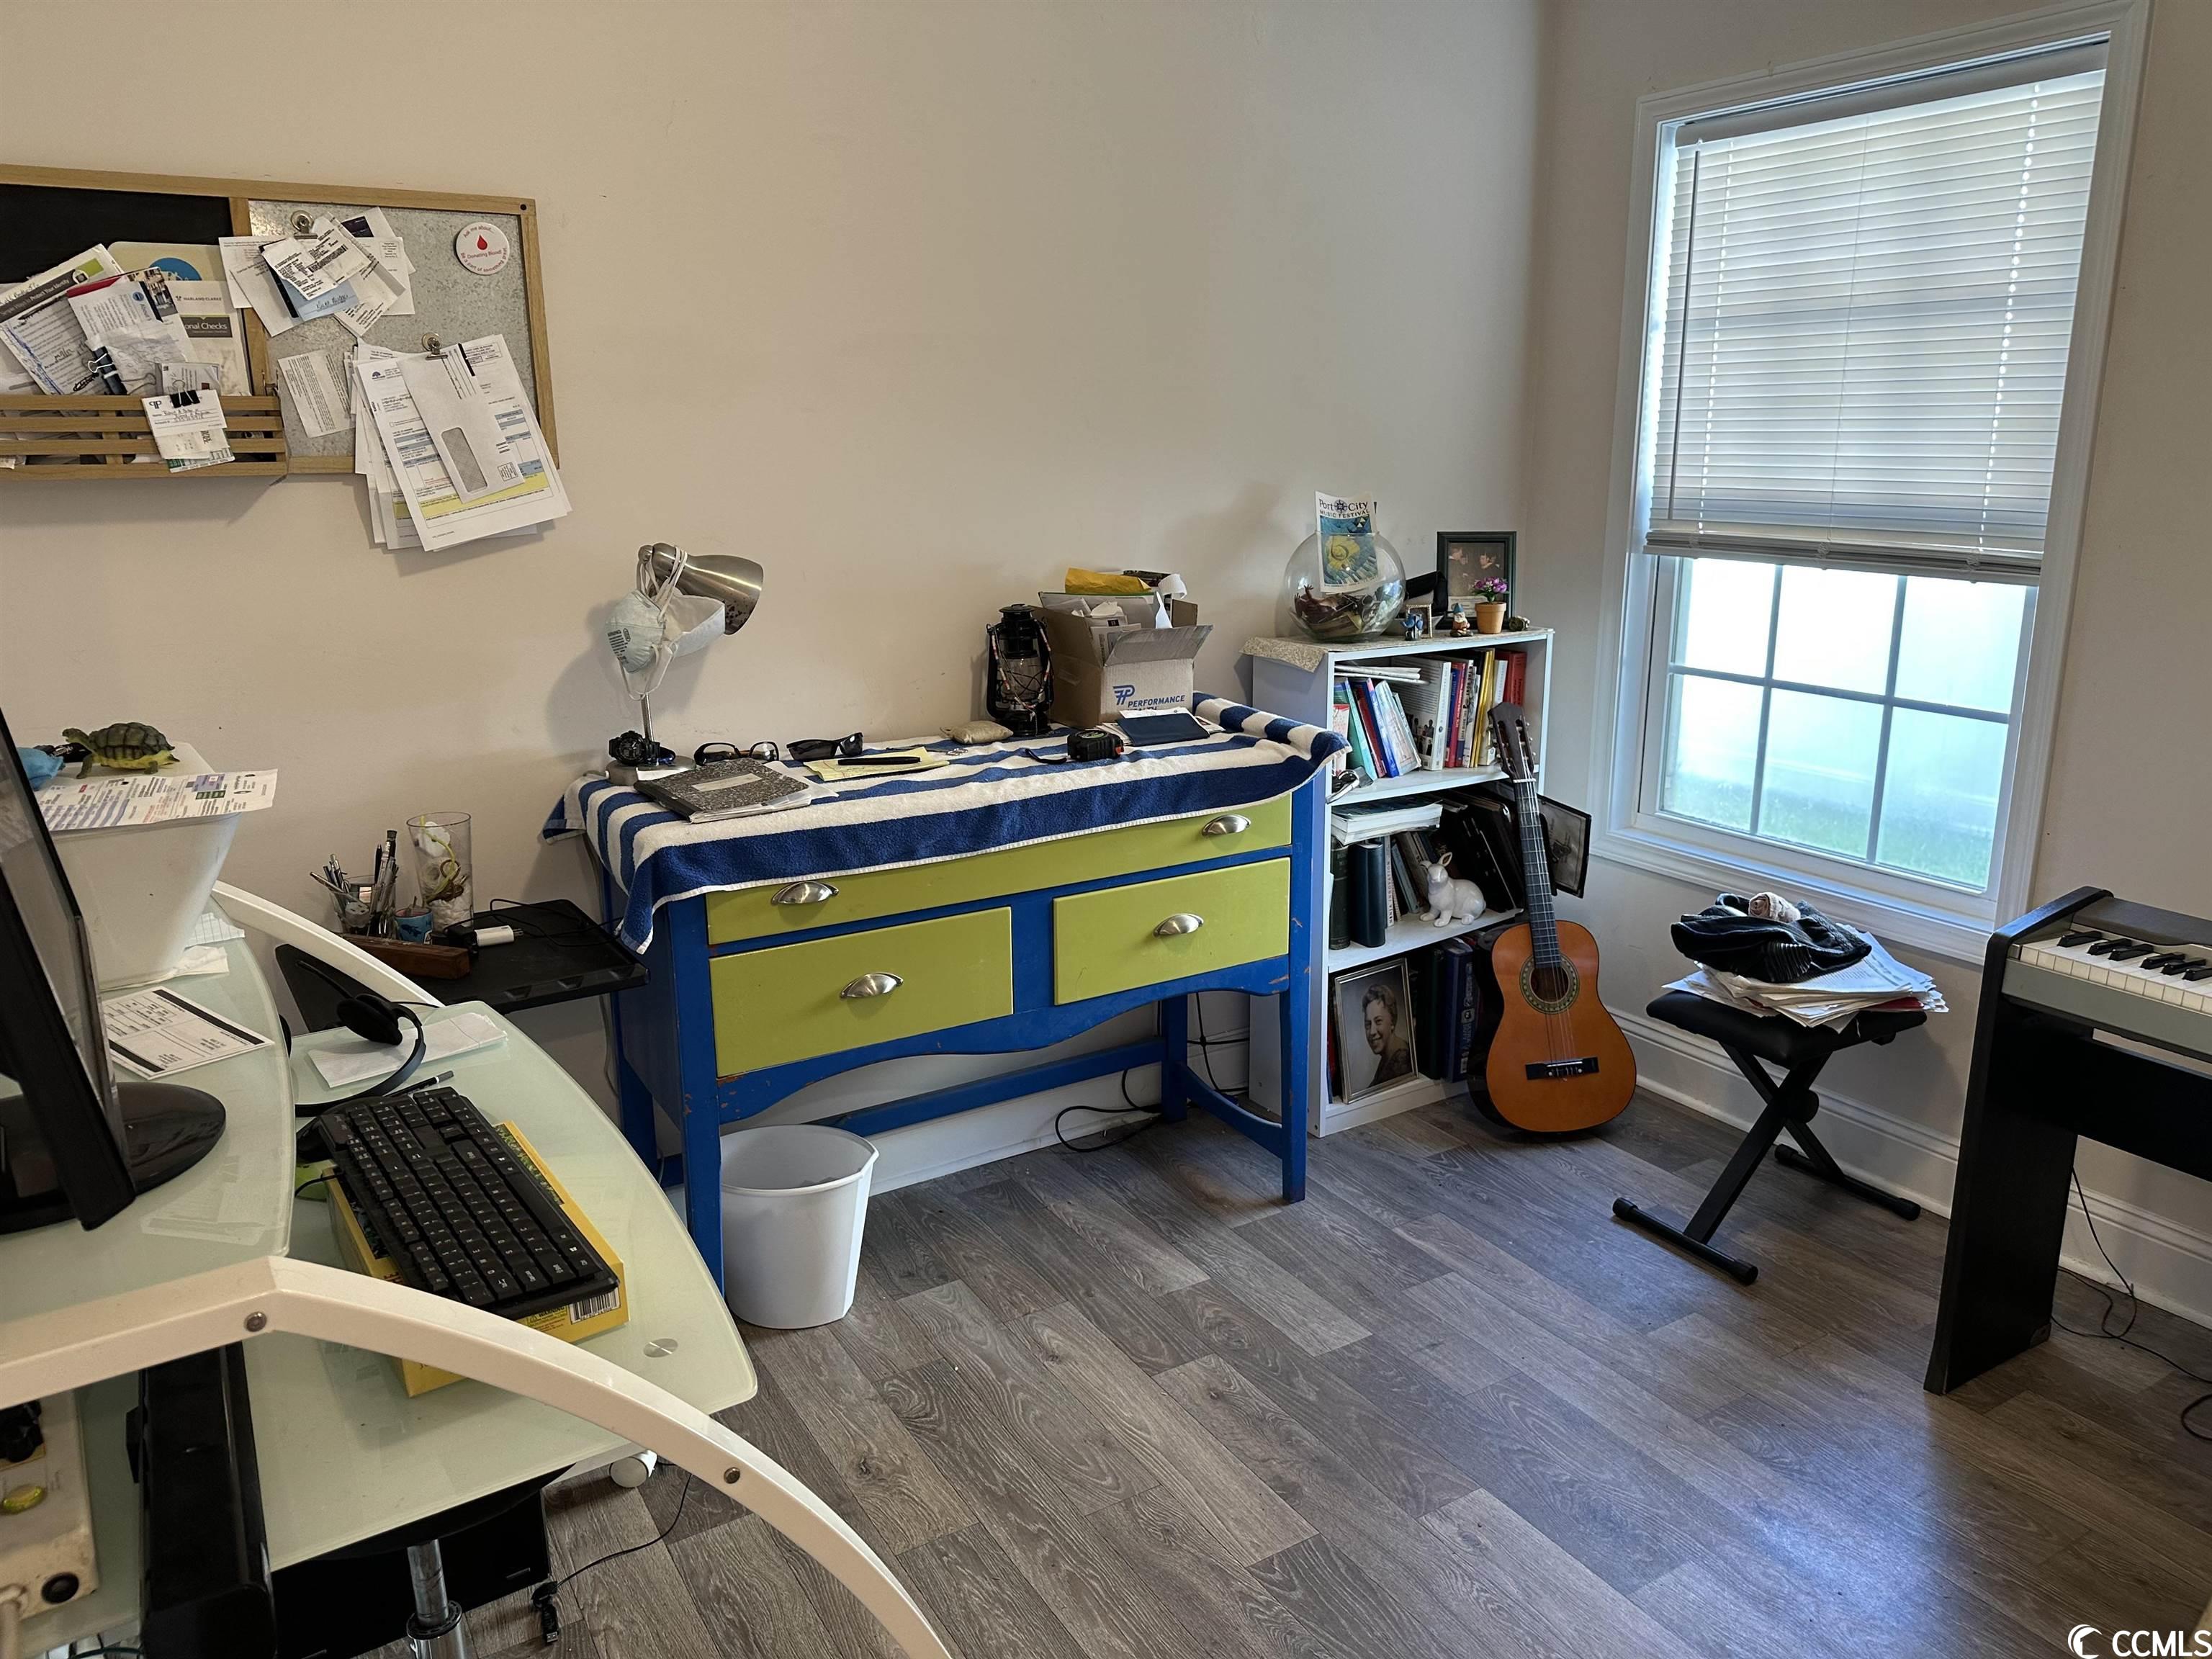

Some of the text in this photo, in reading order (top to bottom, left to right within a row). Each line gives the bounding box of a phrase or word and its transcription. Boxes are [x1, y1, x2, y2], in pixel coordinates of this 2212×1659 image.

[1319, 499, 1368, 511] Port City
[1320, 509, 1370, 518] MUSIC FESTIVAL
[1128, 695, 1186, 708] PERFORMANCE
